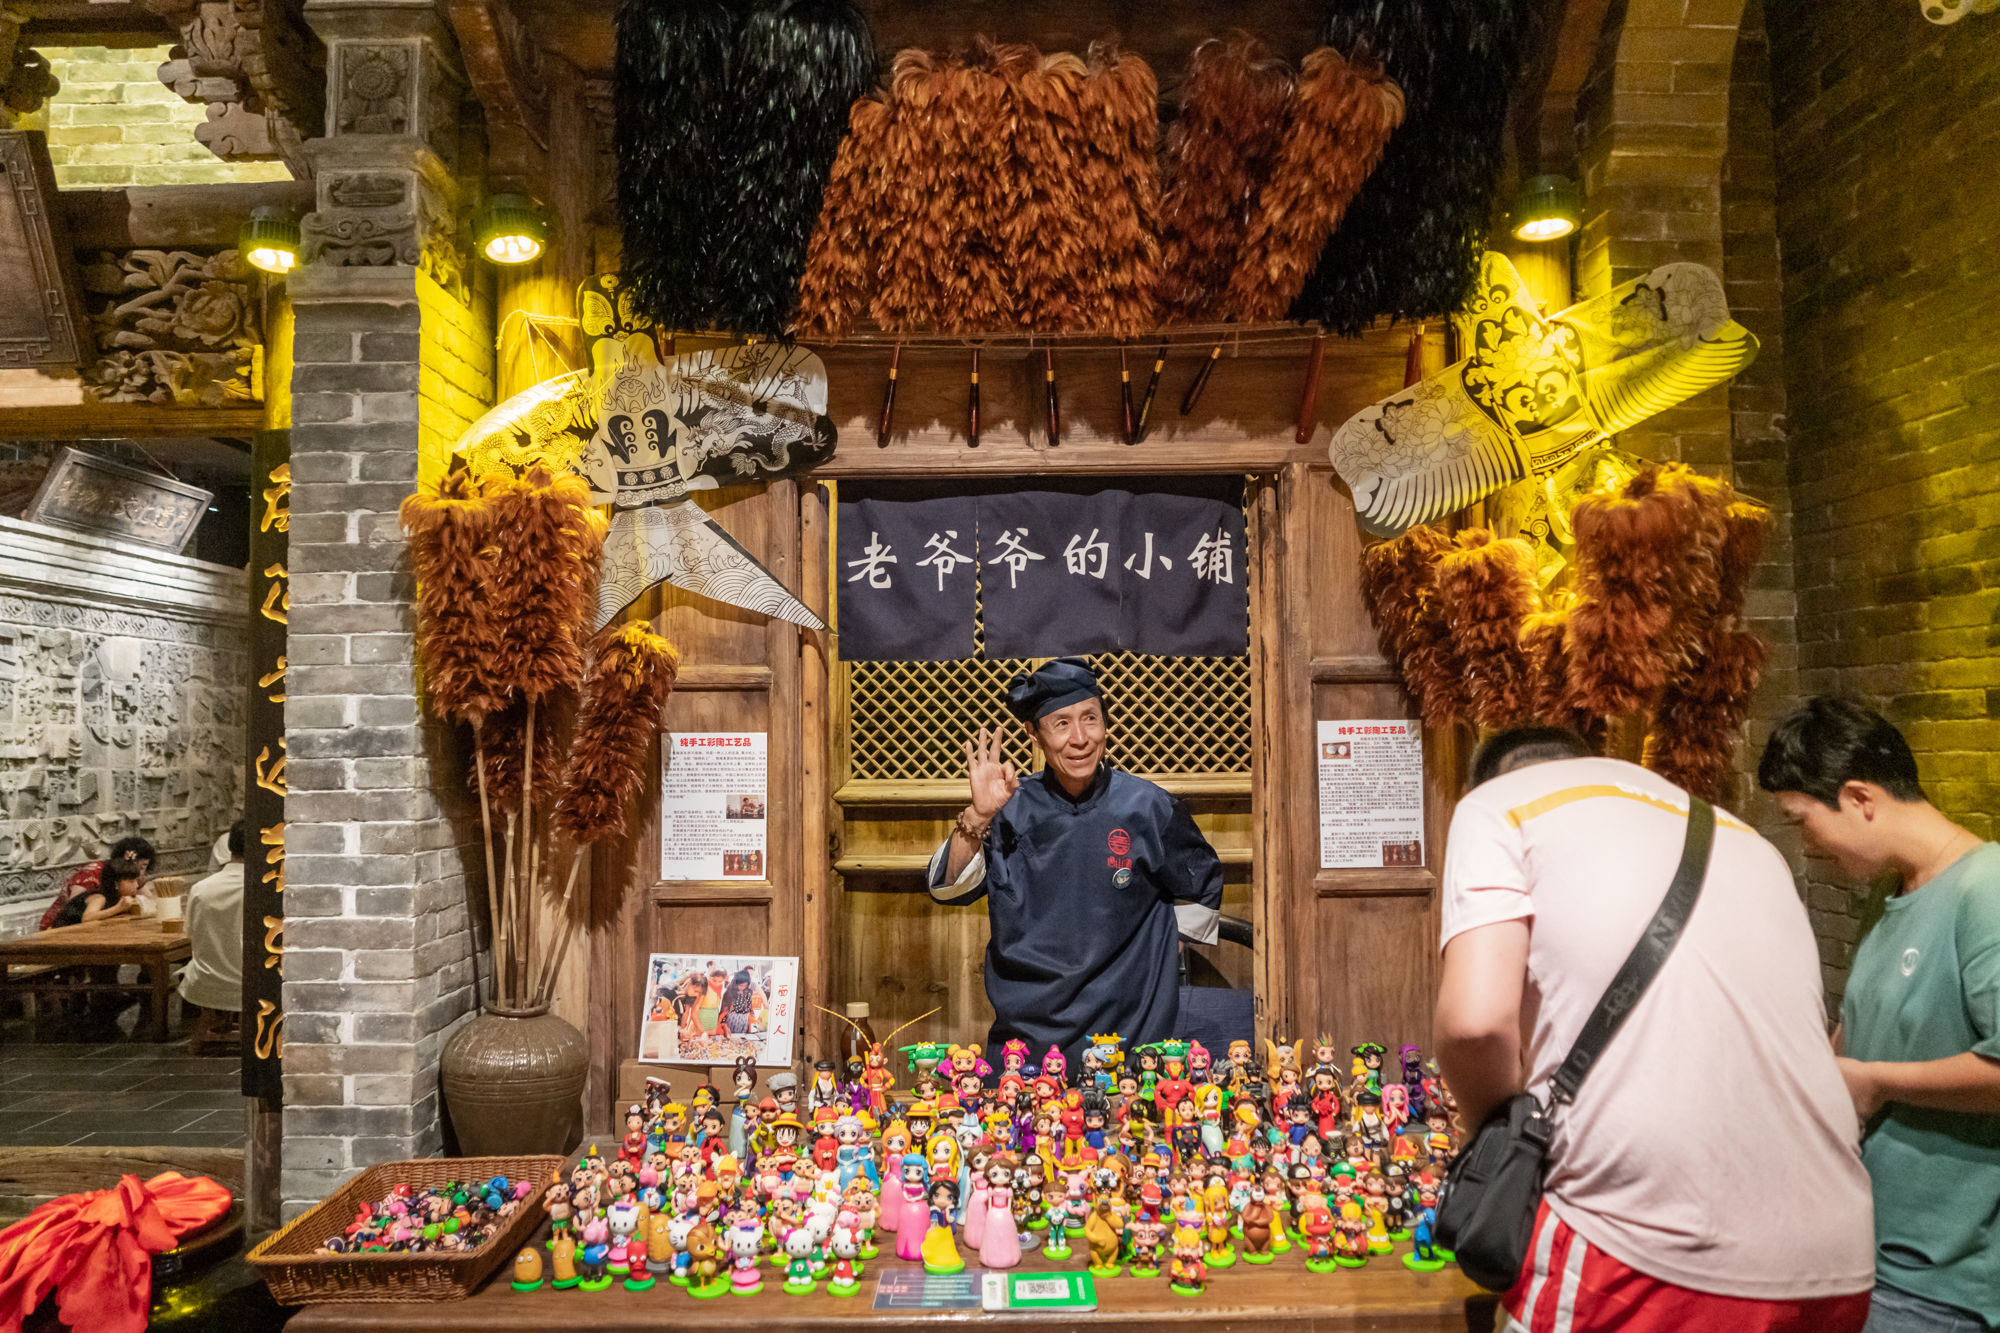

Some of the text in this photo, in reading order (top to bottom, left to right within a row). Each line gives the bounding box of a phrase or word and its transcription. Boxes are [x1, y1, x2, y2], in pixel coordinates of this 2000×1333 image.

[847, 527, 1234, 592] 老爷爷的小铺
[1338, 726, 1406, 735] 纯手工彩陶工艺品
[680, 737, 752, 747] 纯手工彩陶工艺品
